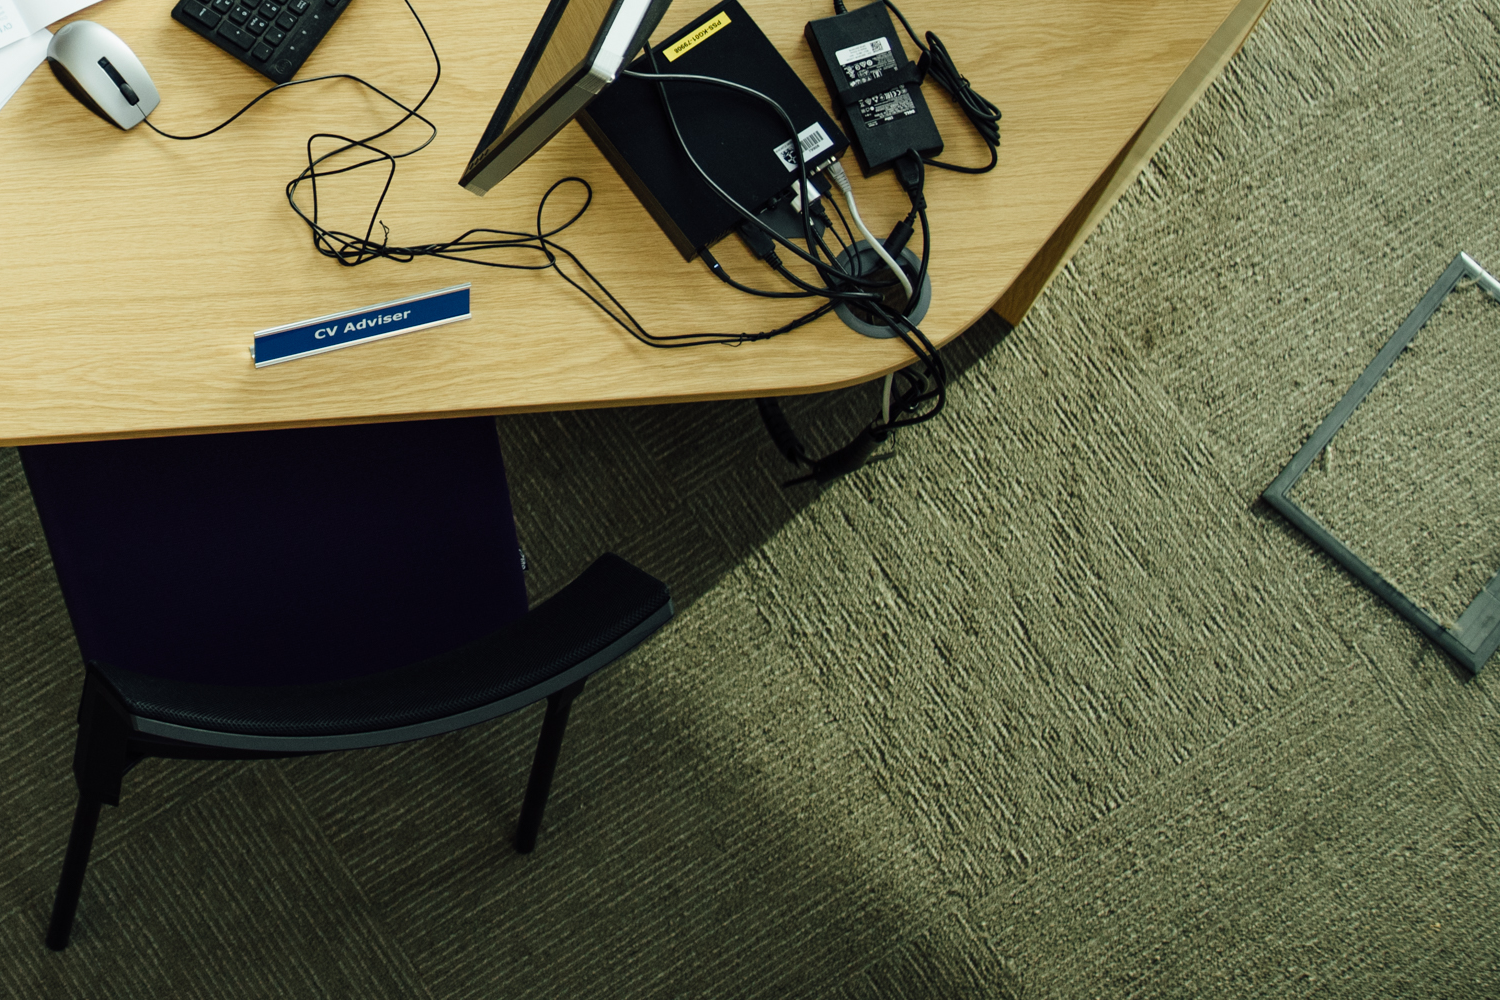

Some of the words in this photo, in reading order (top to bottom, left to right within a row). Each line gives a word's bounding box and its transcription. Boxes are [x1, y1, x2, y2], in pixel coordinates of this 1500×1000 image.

[1, 21, 13, 31] CV
[314, 325, 338, 341] CV
[343, 309, 411, 333] Adviser
